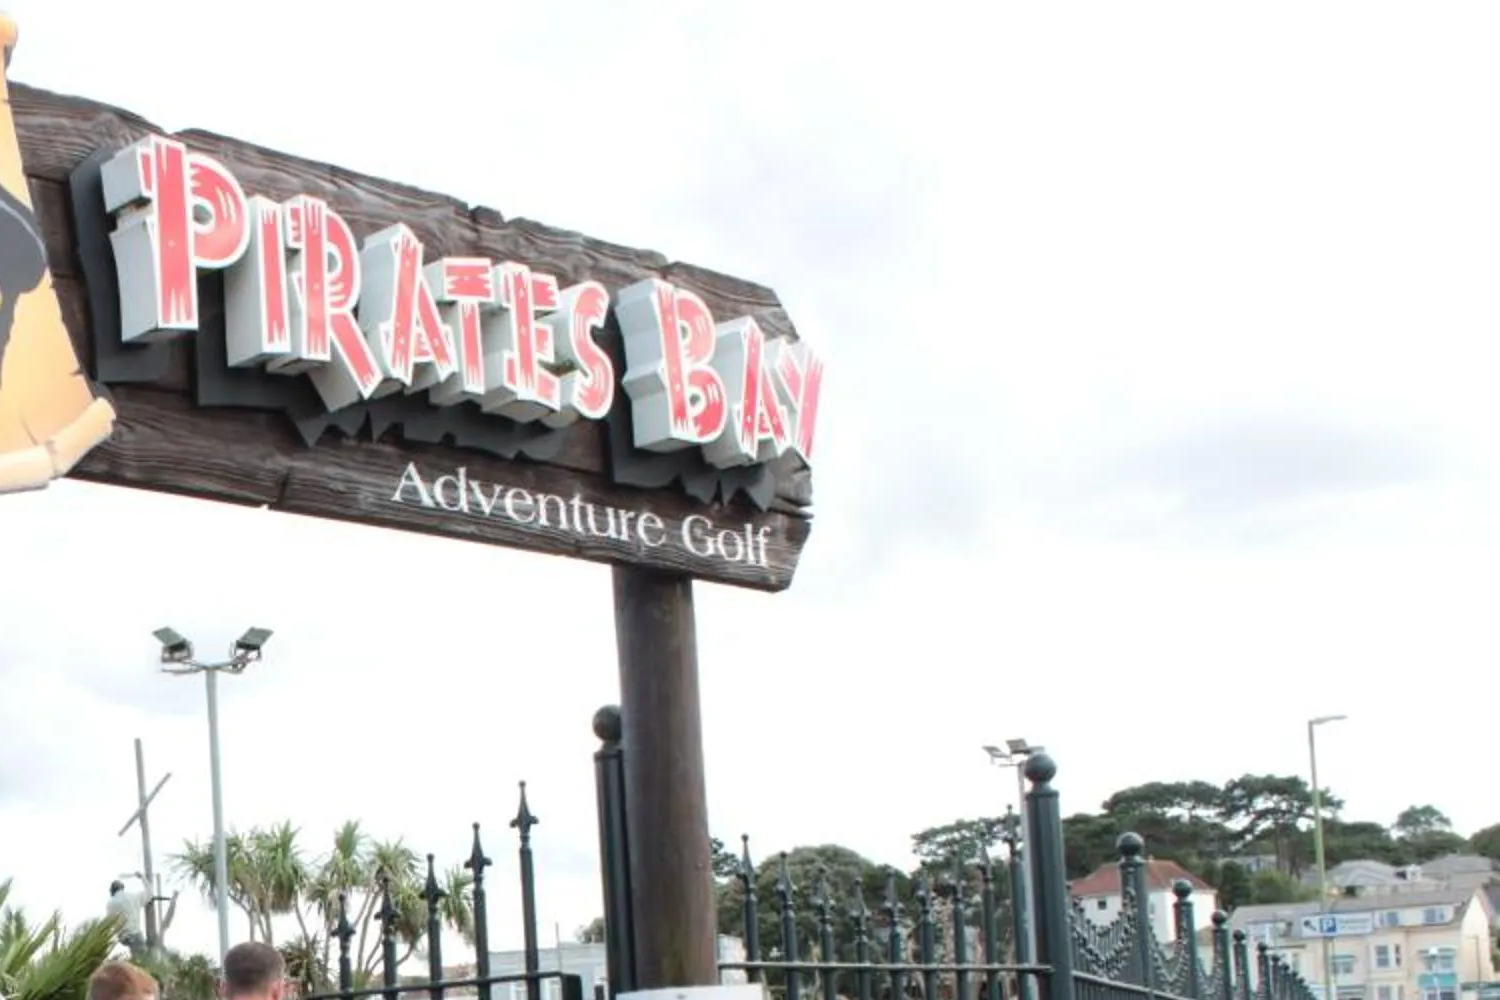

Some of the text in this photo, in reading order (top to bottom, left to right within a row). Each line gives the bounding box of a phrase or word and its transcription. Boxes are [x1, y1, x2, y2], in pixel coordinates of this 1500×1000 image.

[132, 132, 824, 463] PIRATES BAY
[390, 461, 771, 568] Adventure Golf
